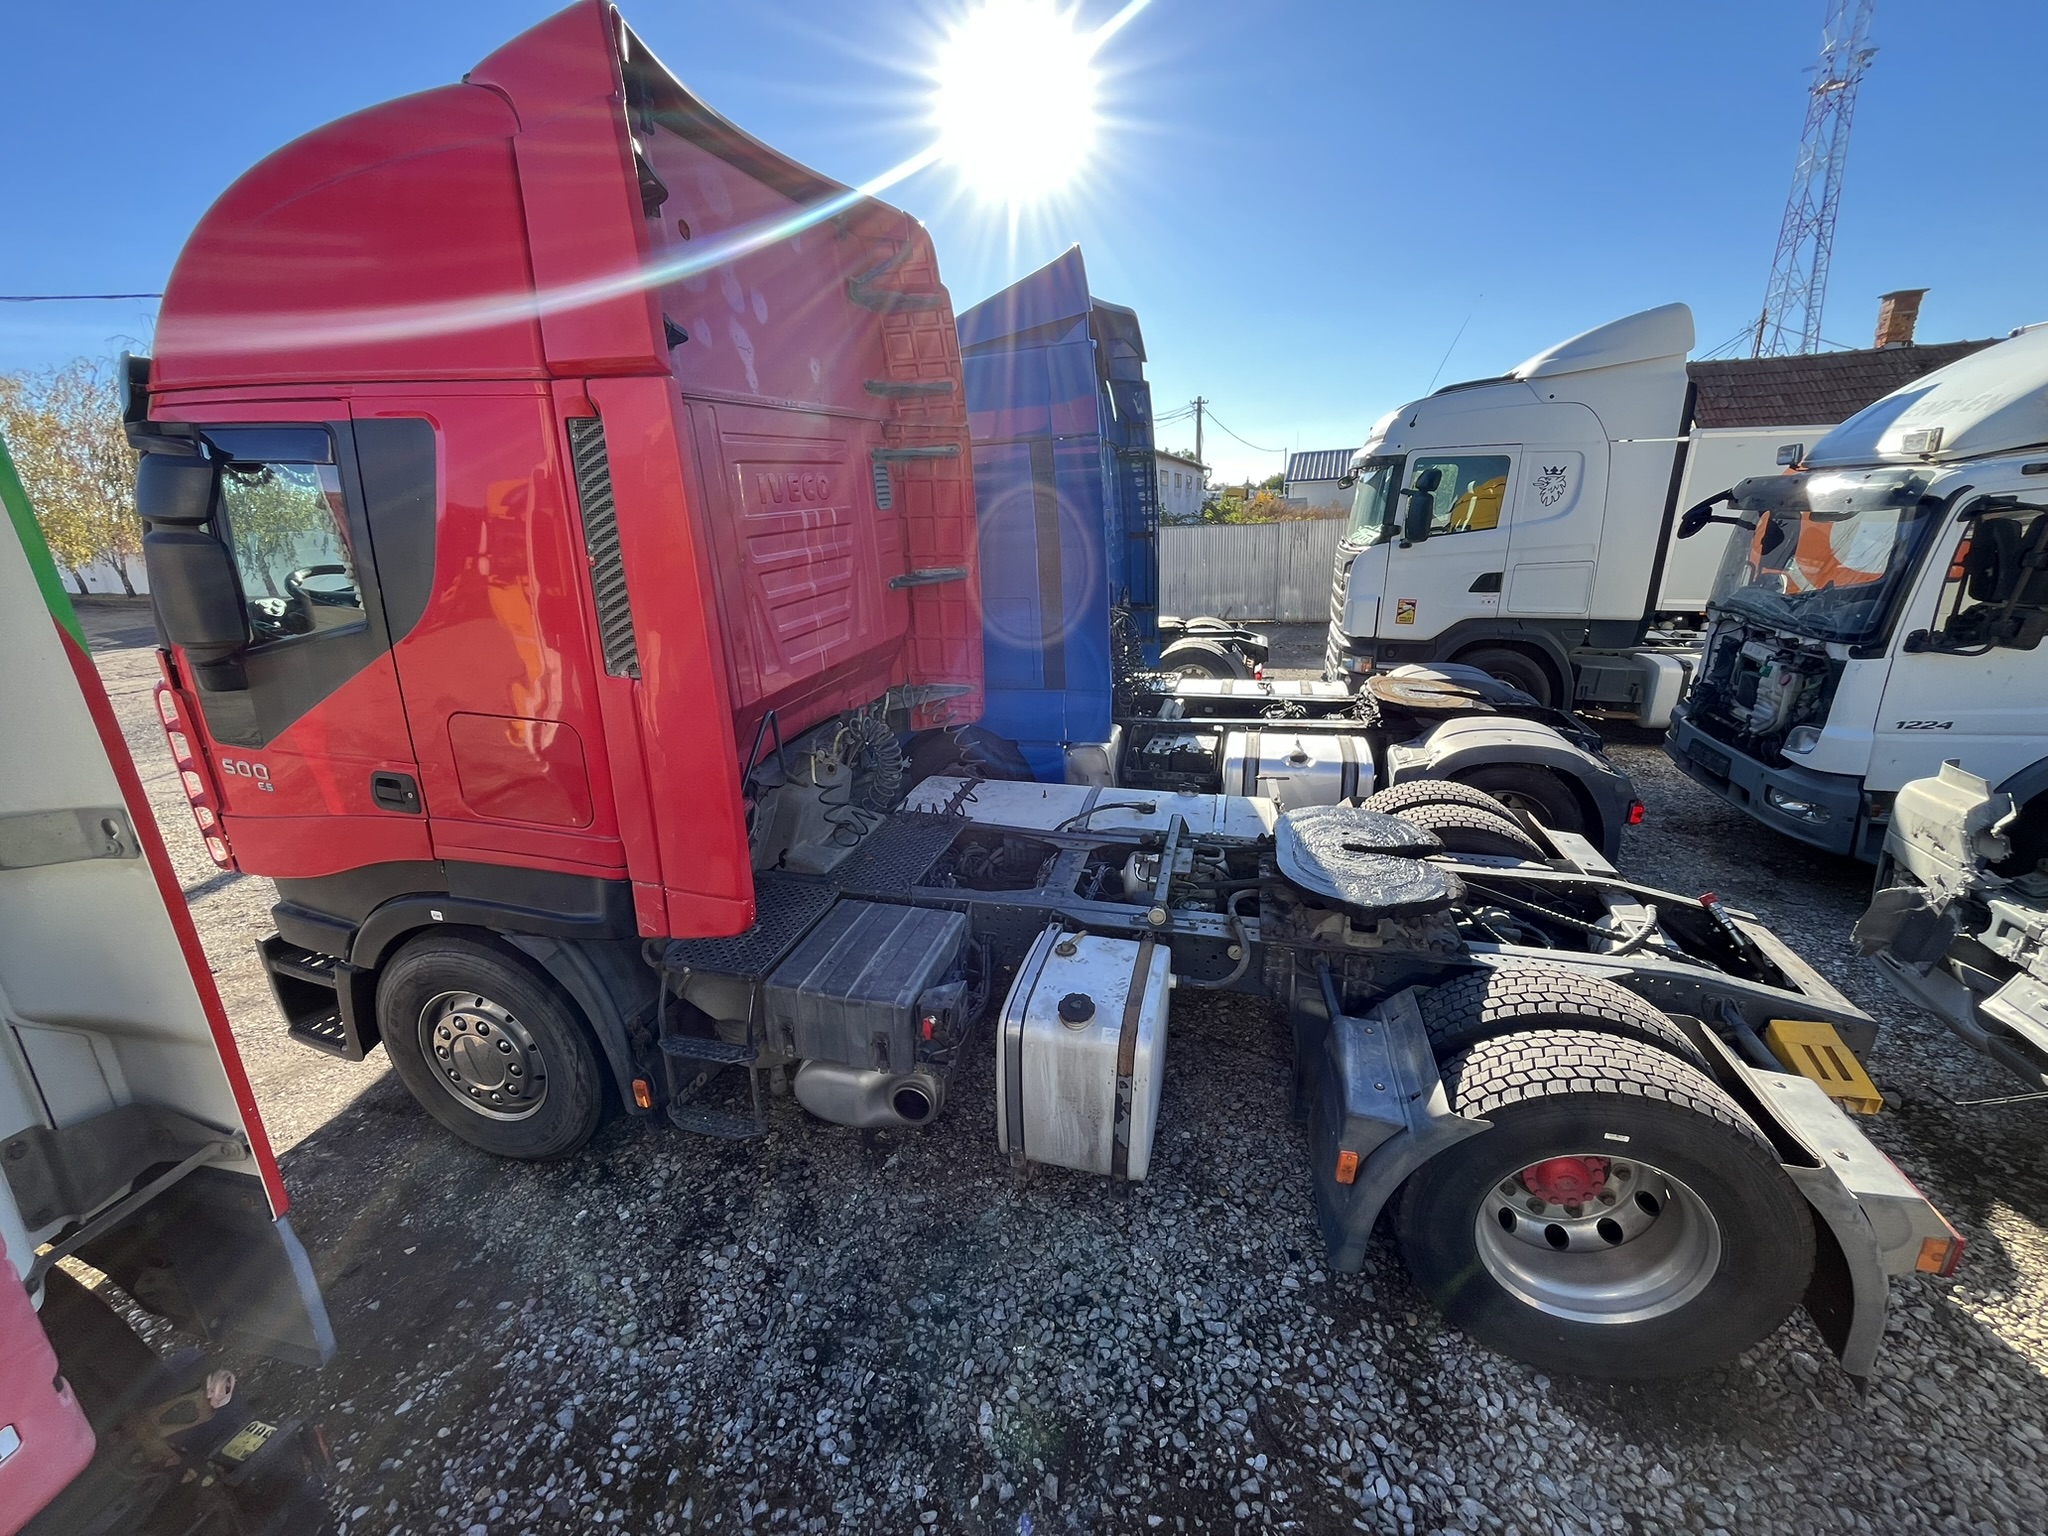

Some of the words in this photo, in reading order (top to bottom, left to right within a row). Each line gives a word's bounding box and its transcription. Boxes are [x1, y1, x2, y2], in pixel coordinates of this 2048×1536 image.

[756, 472, 830, 504] IVECO
[1896, 720, 1954, 730] 1224
[222, 758, 270, 780] 500
